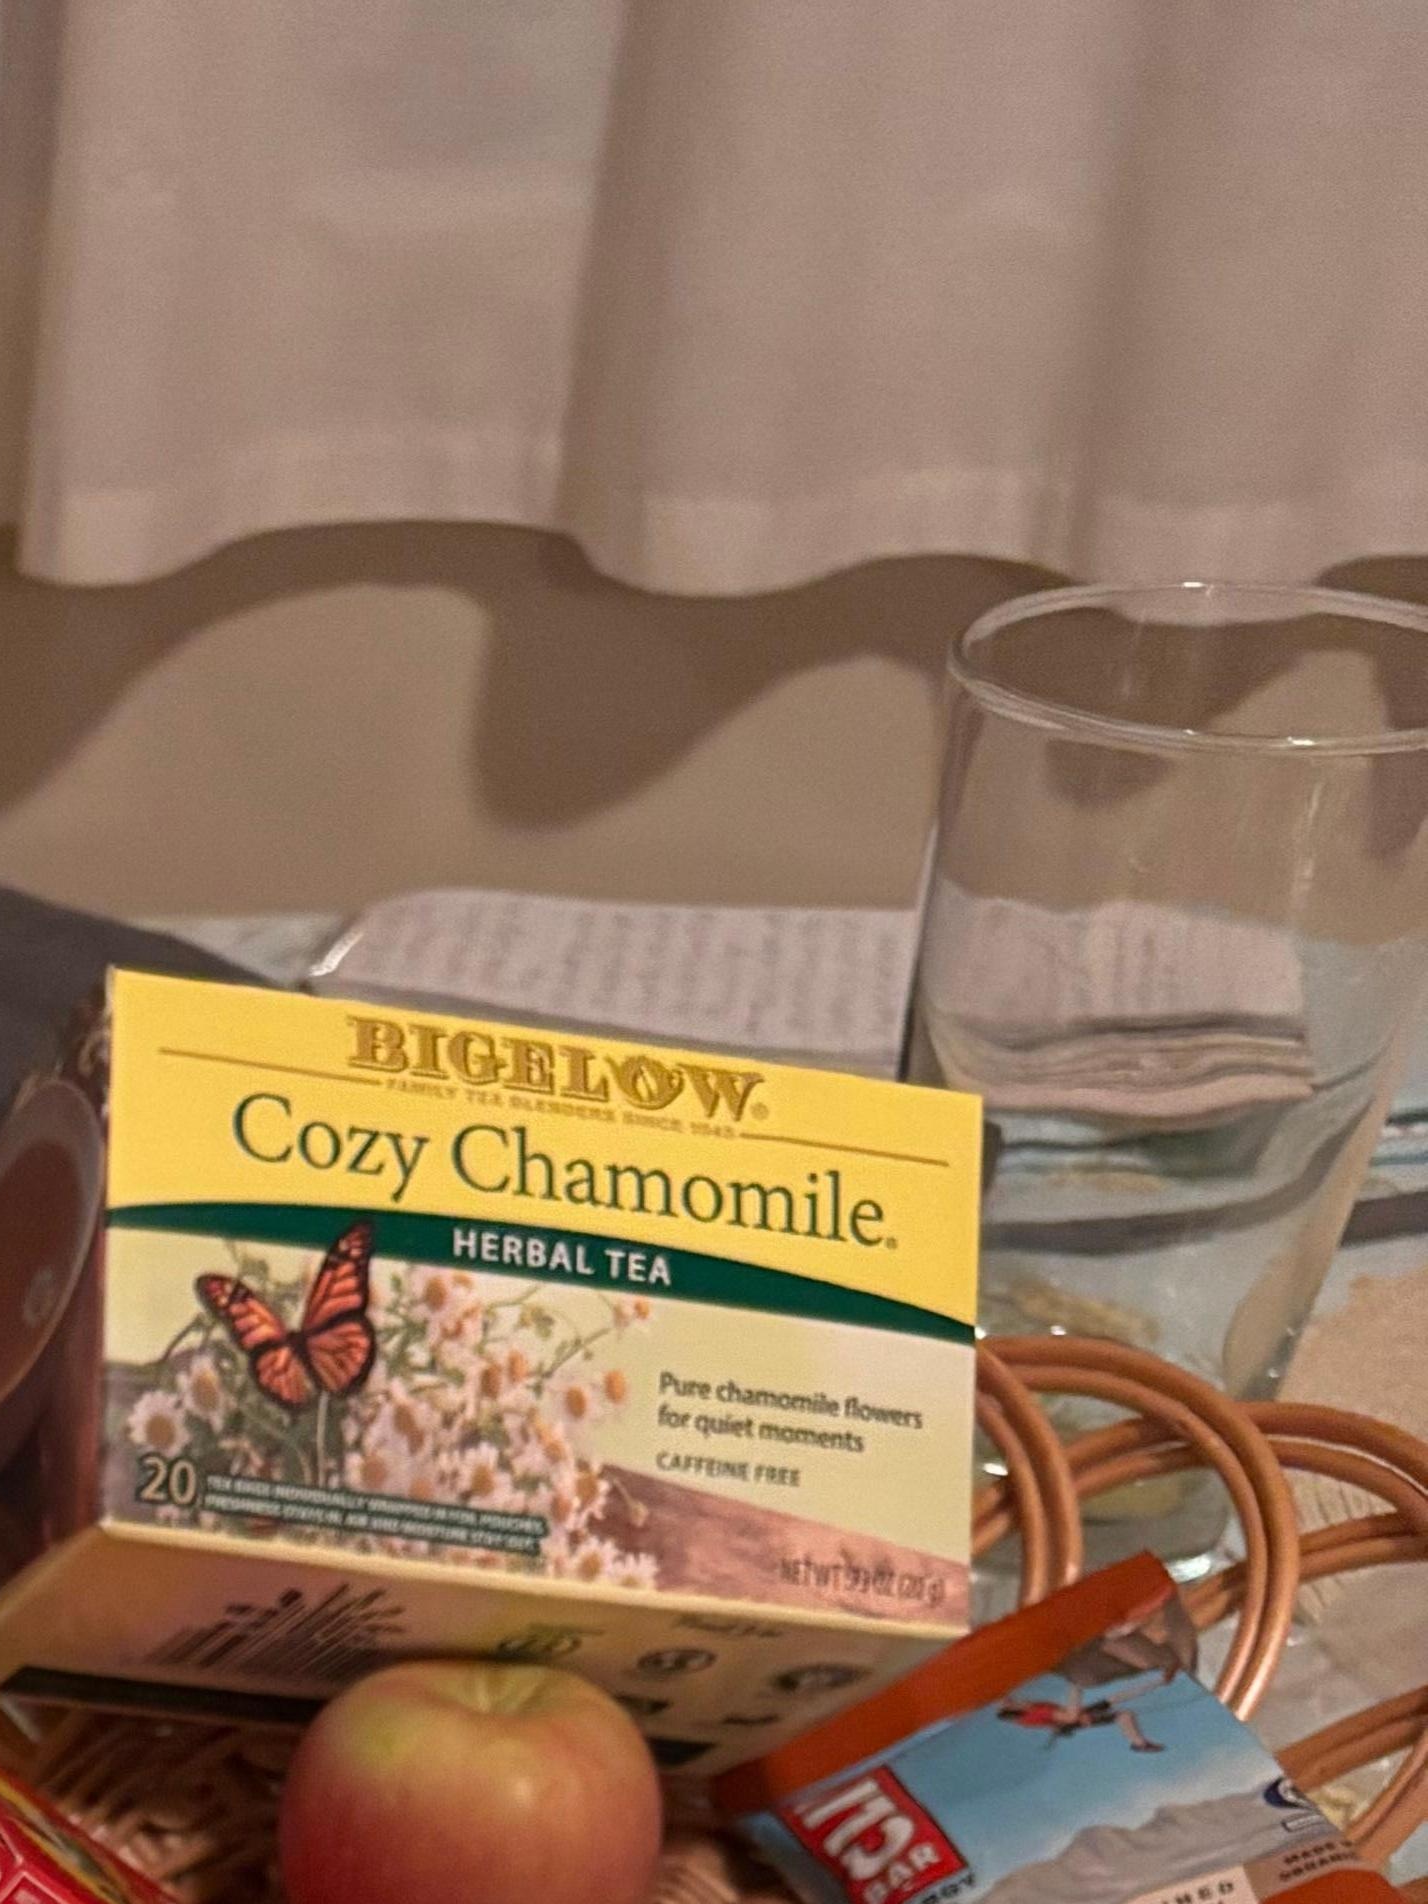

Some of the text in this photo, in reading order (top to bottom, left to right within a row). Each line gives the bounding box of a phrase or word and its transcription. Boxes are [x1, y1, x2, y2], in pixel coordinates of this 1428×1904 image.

[348, 1016, 764, 1122] BIGELOW
[232, 1092, 886, 1248] Cozy Chamomile
[453, 1226, 673, 1286] HERBAL TEA
[657, 1402, 865, 1451] for quiet moments
[659, 1371, 924, 1429] Pure chamomile flowers
[139, 1456, 197, 1505] 20
[655, 1450, 801, 1487] CAFFEINE FREE
